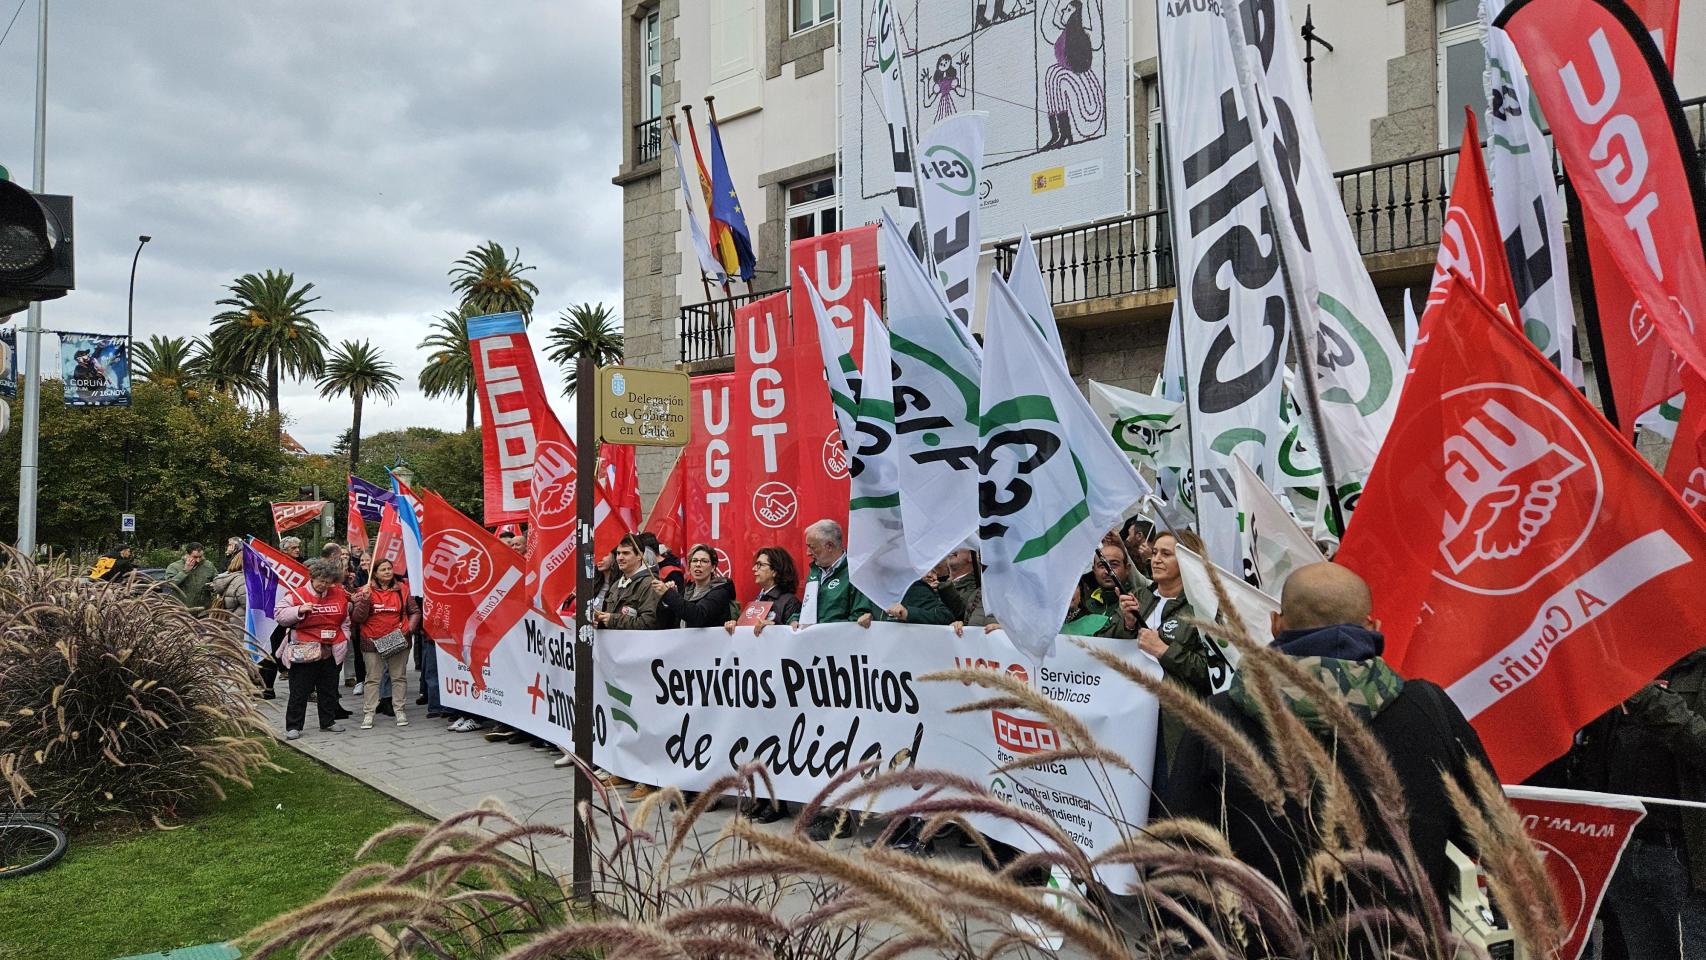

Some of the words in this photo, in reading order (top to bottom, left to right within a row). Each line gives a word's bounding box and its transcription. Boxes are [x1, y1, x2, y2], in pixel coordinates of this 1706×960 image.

[628, 392, 684, 406] Delegación
[749, 312, 788, 473] UGT
[610, 408, 628, 419] del
[633, 408, 684, 422] Gobierno
[619, 426, 633, 435] en
[638, 424, 675, 437] Galicia
[702, 387, 730, 540] UGT
[446, 676, 469, 697] UGT
[651, 656, 777, 710] Servicios
[781, 654, 920, 715] Públicos
[1041, 668, 1101, 686] Servicios
[1041, 686, 1091, 704] Públicos
[997, 718, 1054, 750] CCOO
[665, 712, 712, 770] de
[728, 712, 924, 788] calidad
[1016, 783, 1050, 800] Central
[1052, 791, 1091, 811] Sindical
[1087, 820, 1094, 832] y
